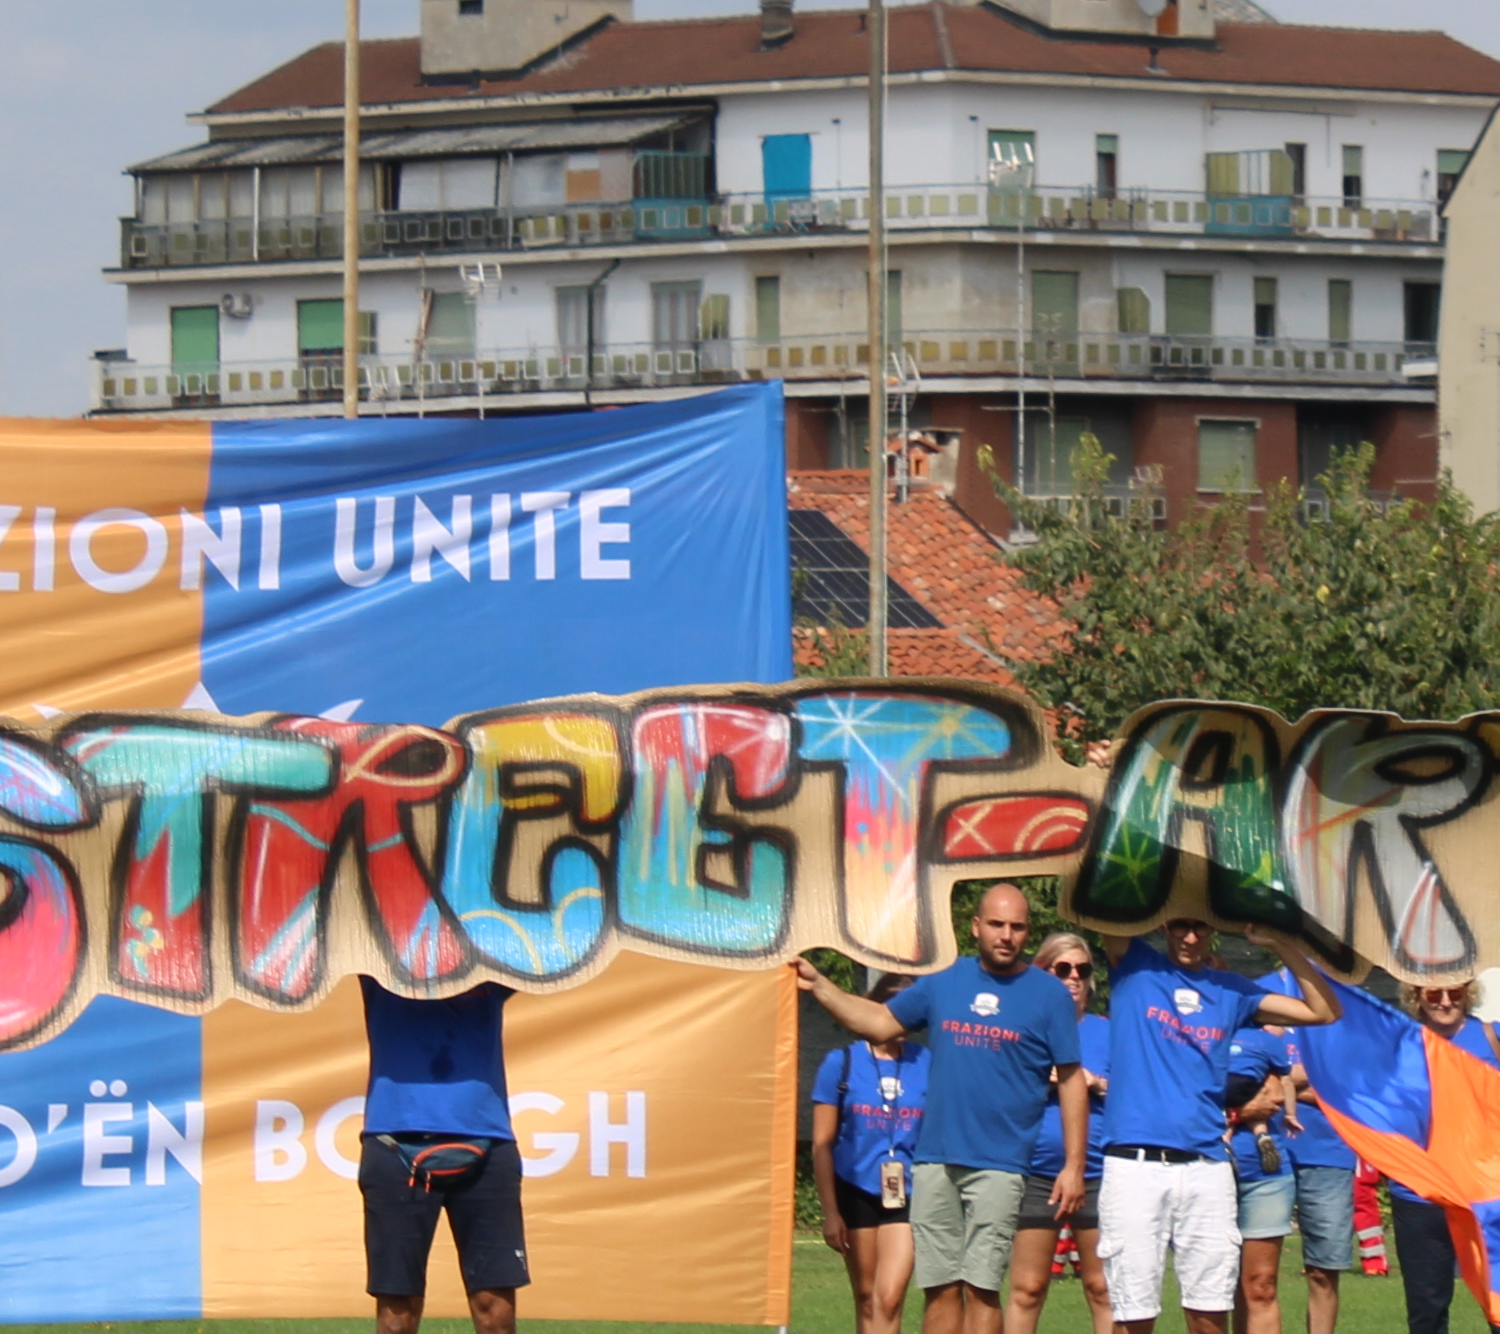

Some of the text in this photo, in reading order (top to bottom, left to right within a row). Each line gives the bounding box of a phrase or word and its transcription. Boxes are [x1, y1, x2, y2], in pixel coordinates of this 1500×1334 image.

[331, 487, 632, 589] UNITE
[941, 1019, 1022, 1043] FRAZIONI
[954, 1035, 1002, 1052] UNITE
